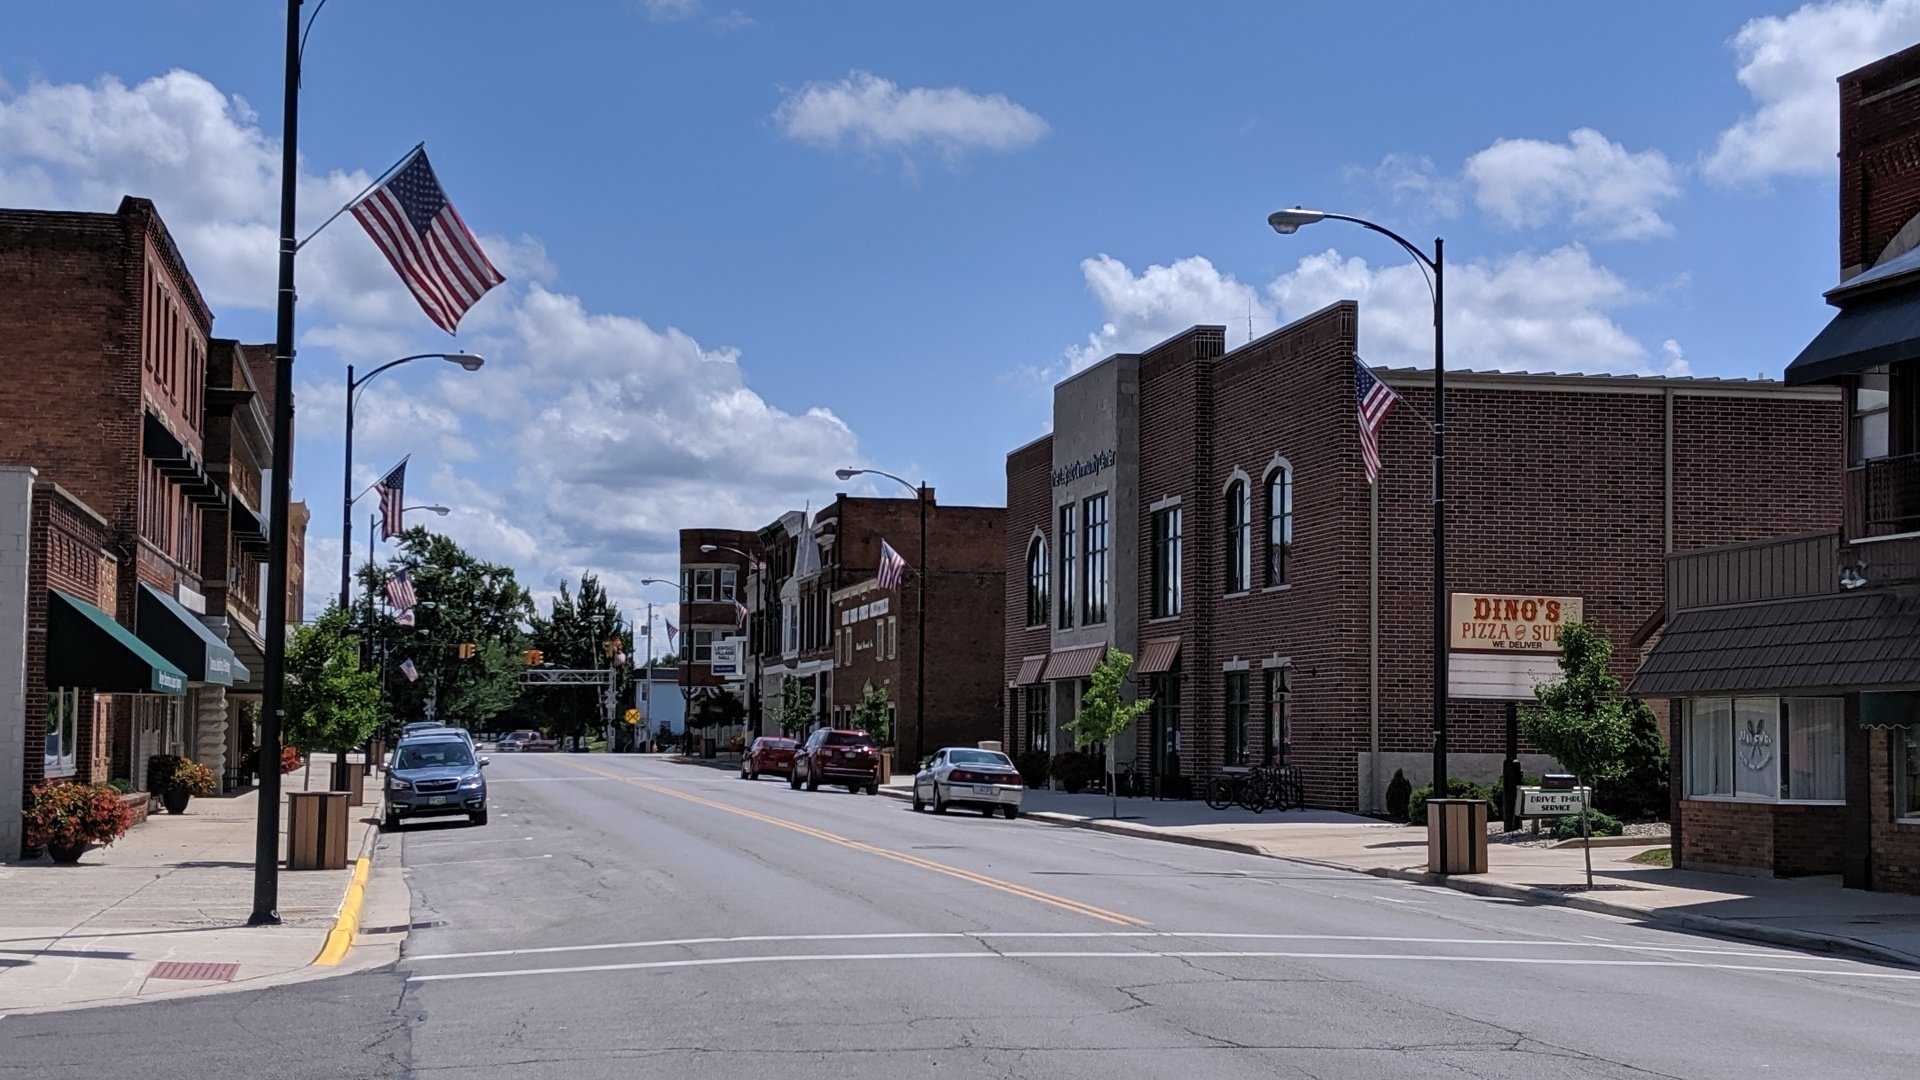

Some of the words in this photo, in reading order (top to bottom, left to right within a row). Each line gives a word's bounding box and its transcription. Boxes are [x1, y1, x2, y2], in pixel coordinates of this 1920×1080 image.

[1473, 597, 1561, 622] DINO'S
[1461, 622, 1511, 640] PIZZA
[1491, 640, 1506, 648] WE
[1508, 641, 1543, 649] DELIVER
[1530, 795, 1557, 803] DRIVE
[1560, 795, 1582, 803] THRU
